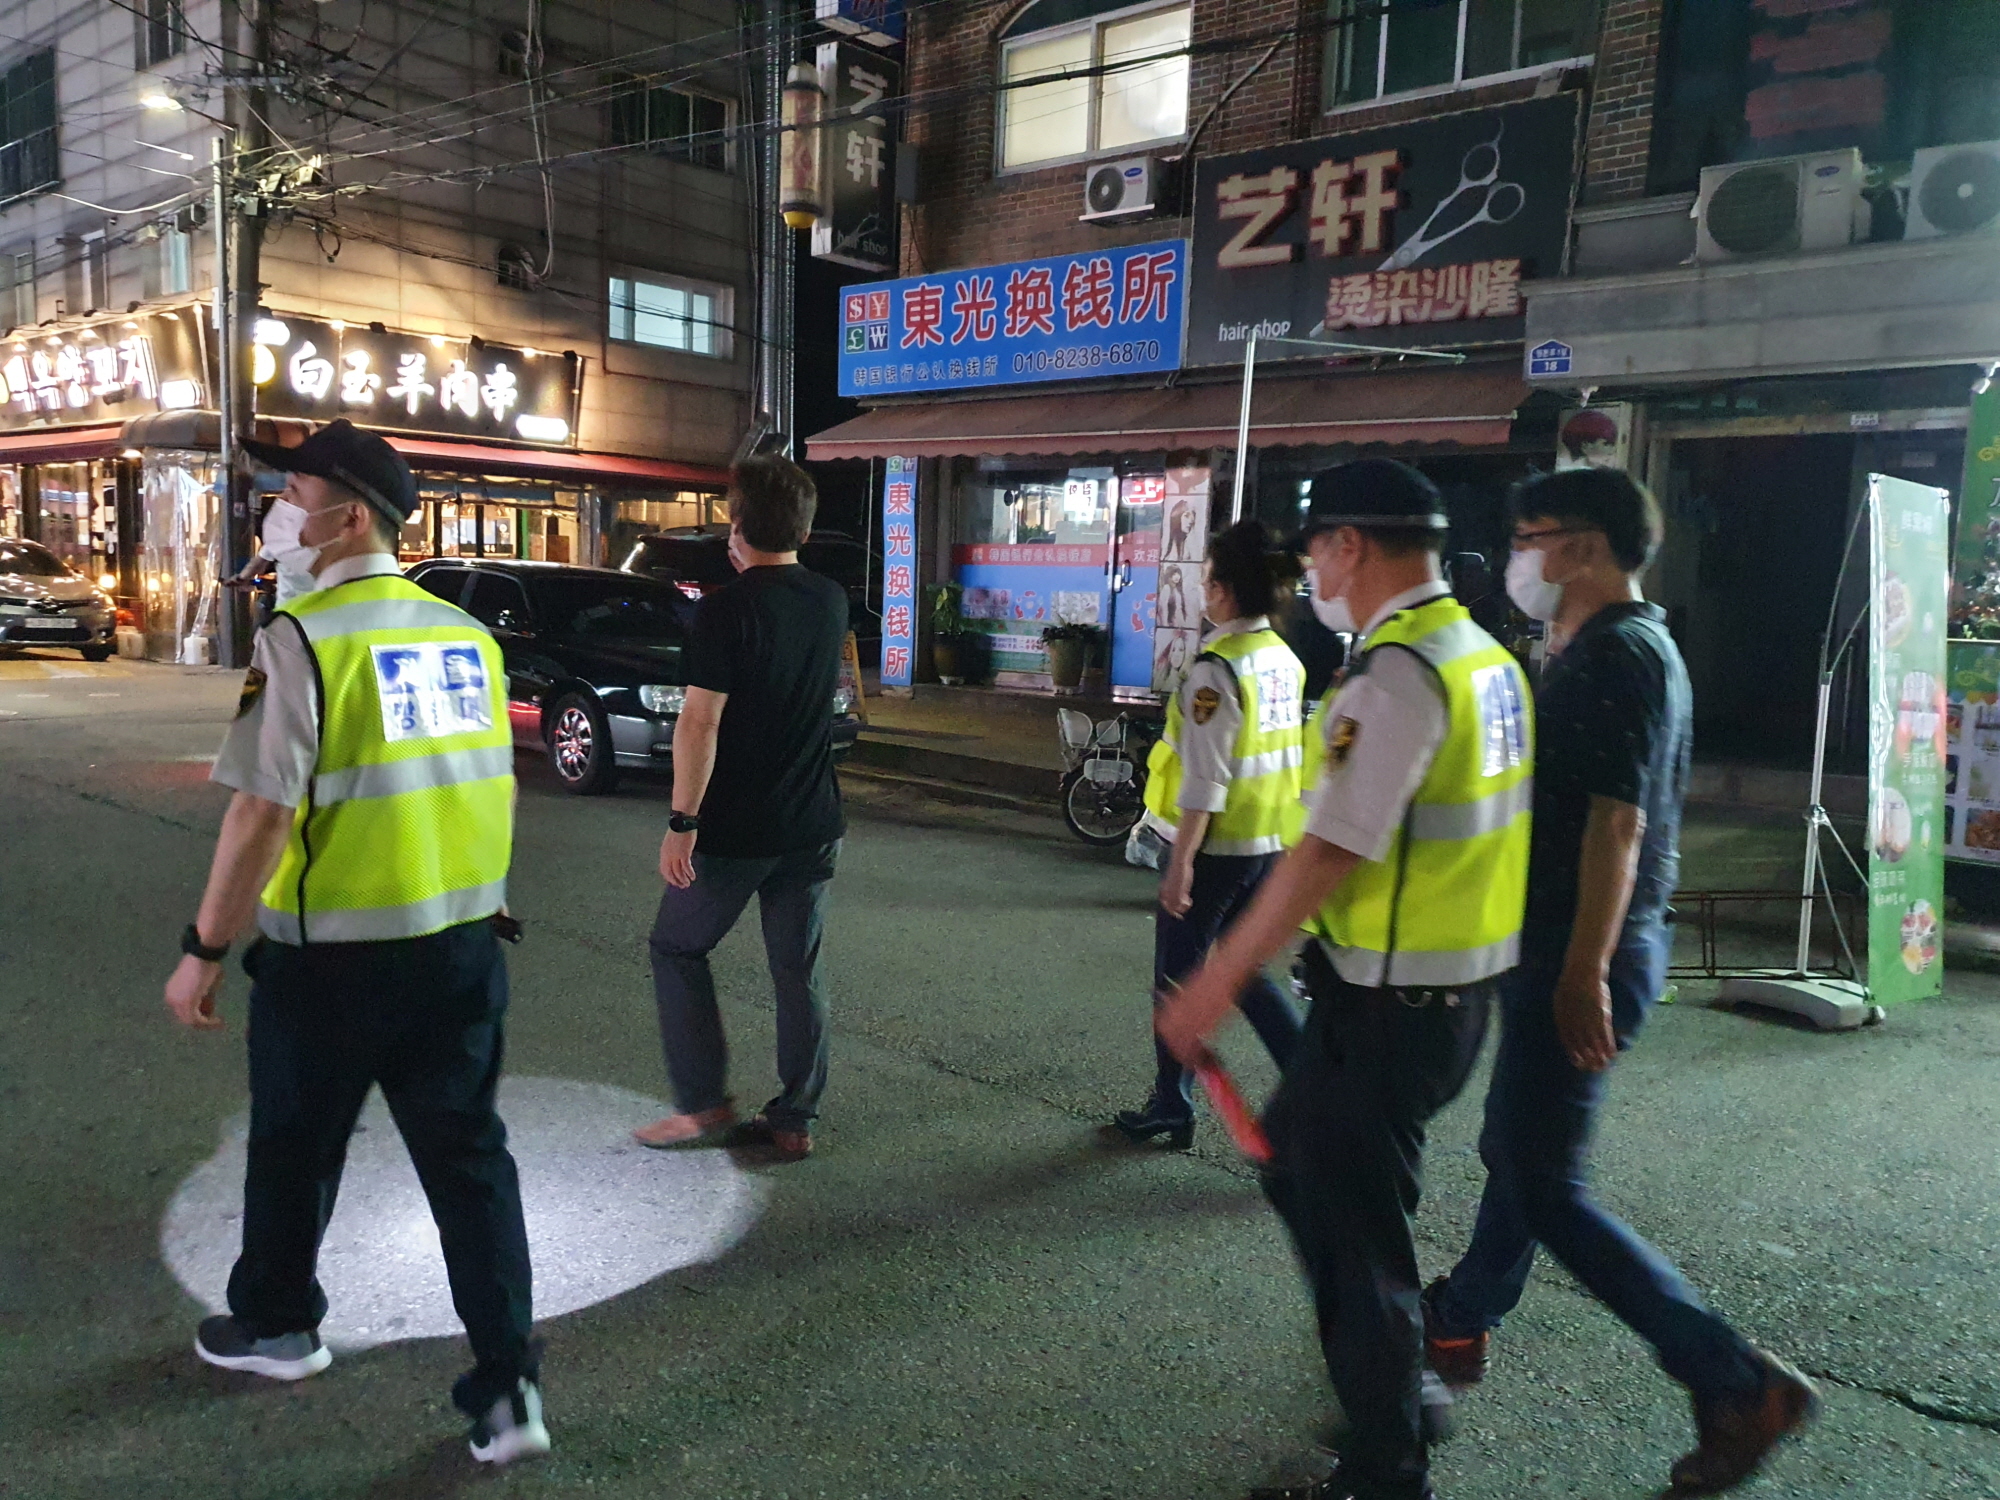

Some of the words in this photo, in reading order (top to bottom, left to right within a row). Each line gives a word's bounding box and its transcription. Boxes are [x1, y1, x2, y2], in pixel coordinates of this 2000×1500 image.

[846, 65, 888, 188] 艺轩
[1216, 149, 1403, 269] 艺轩
[900, 249, 1177, 350] 東光换钱所
[1218, 321, 1249, 341] hair
[1252, 318, 1292, 340] shop
[1324, 258, 1524, 330] 烫染沙隆
[288, 340, 518, 423] 白玉羊肉串
[853, 355, 999, 387] 韩国银行公认换钱所
[1013, 339, 1160, 374] 010-8238-6870
[1544, 361, 1557, 372] 18
[883, 481, 913, 680] 東光换钱所
